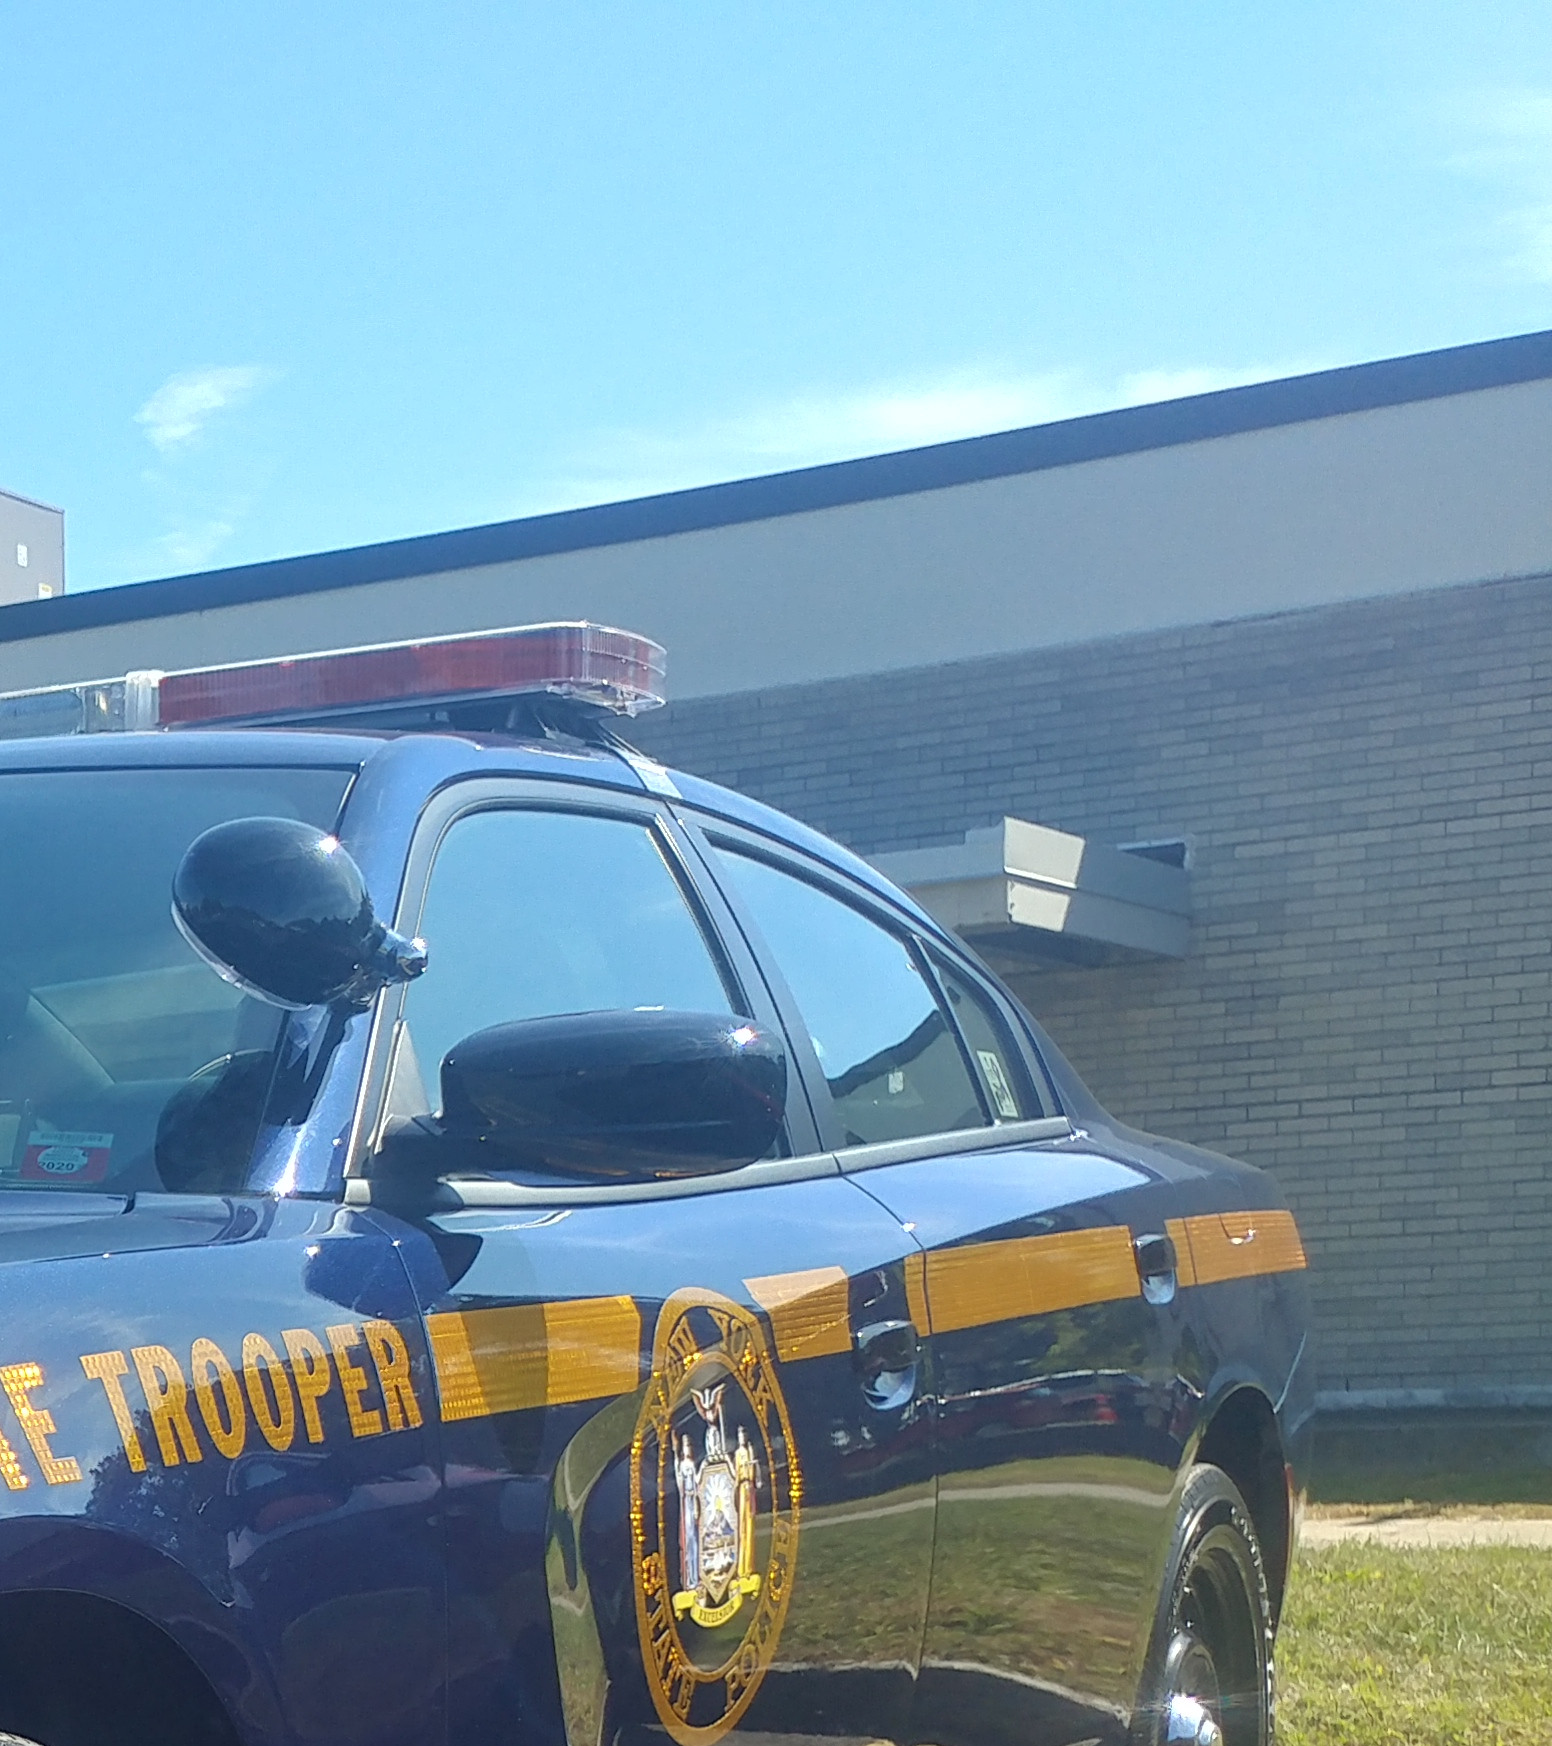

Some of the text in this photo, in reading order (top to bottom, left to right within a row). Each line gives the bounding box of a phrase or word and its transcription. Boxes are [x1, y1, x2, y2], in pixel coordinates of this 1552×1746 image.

[80, 1320, 424, 1473] TROOPER
[707, 1308, 775, 1428] YORK
[641, 1518, 792, 1722] STATE POLICE
